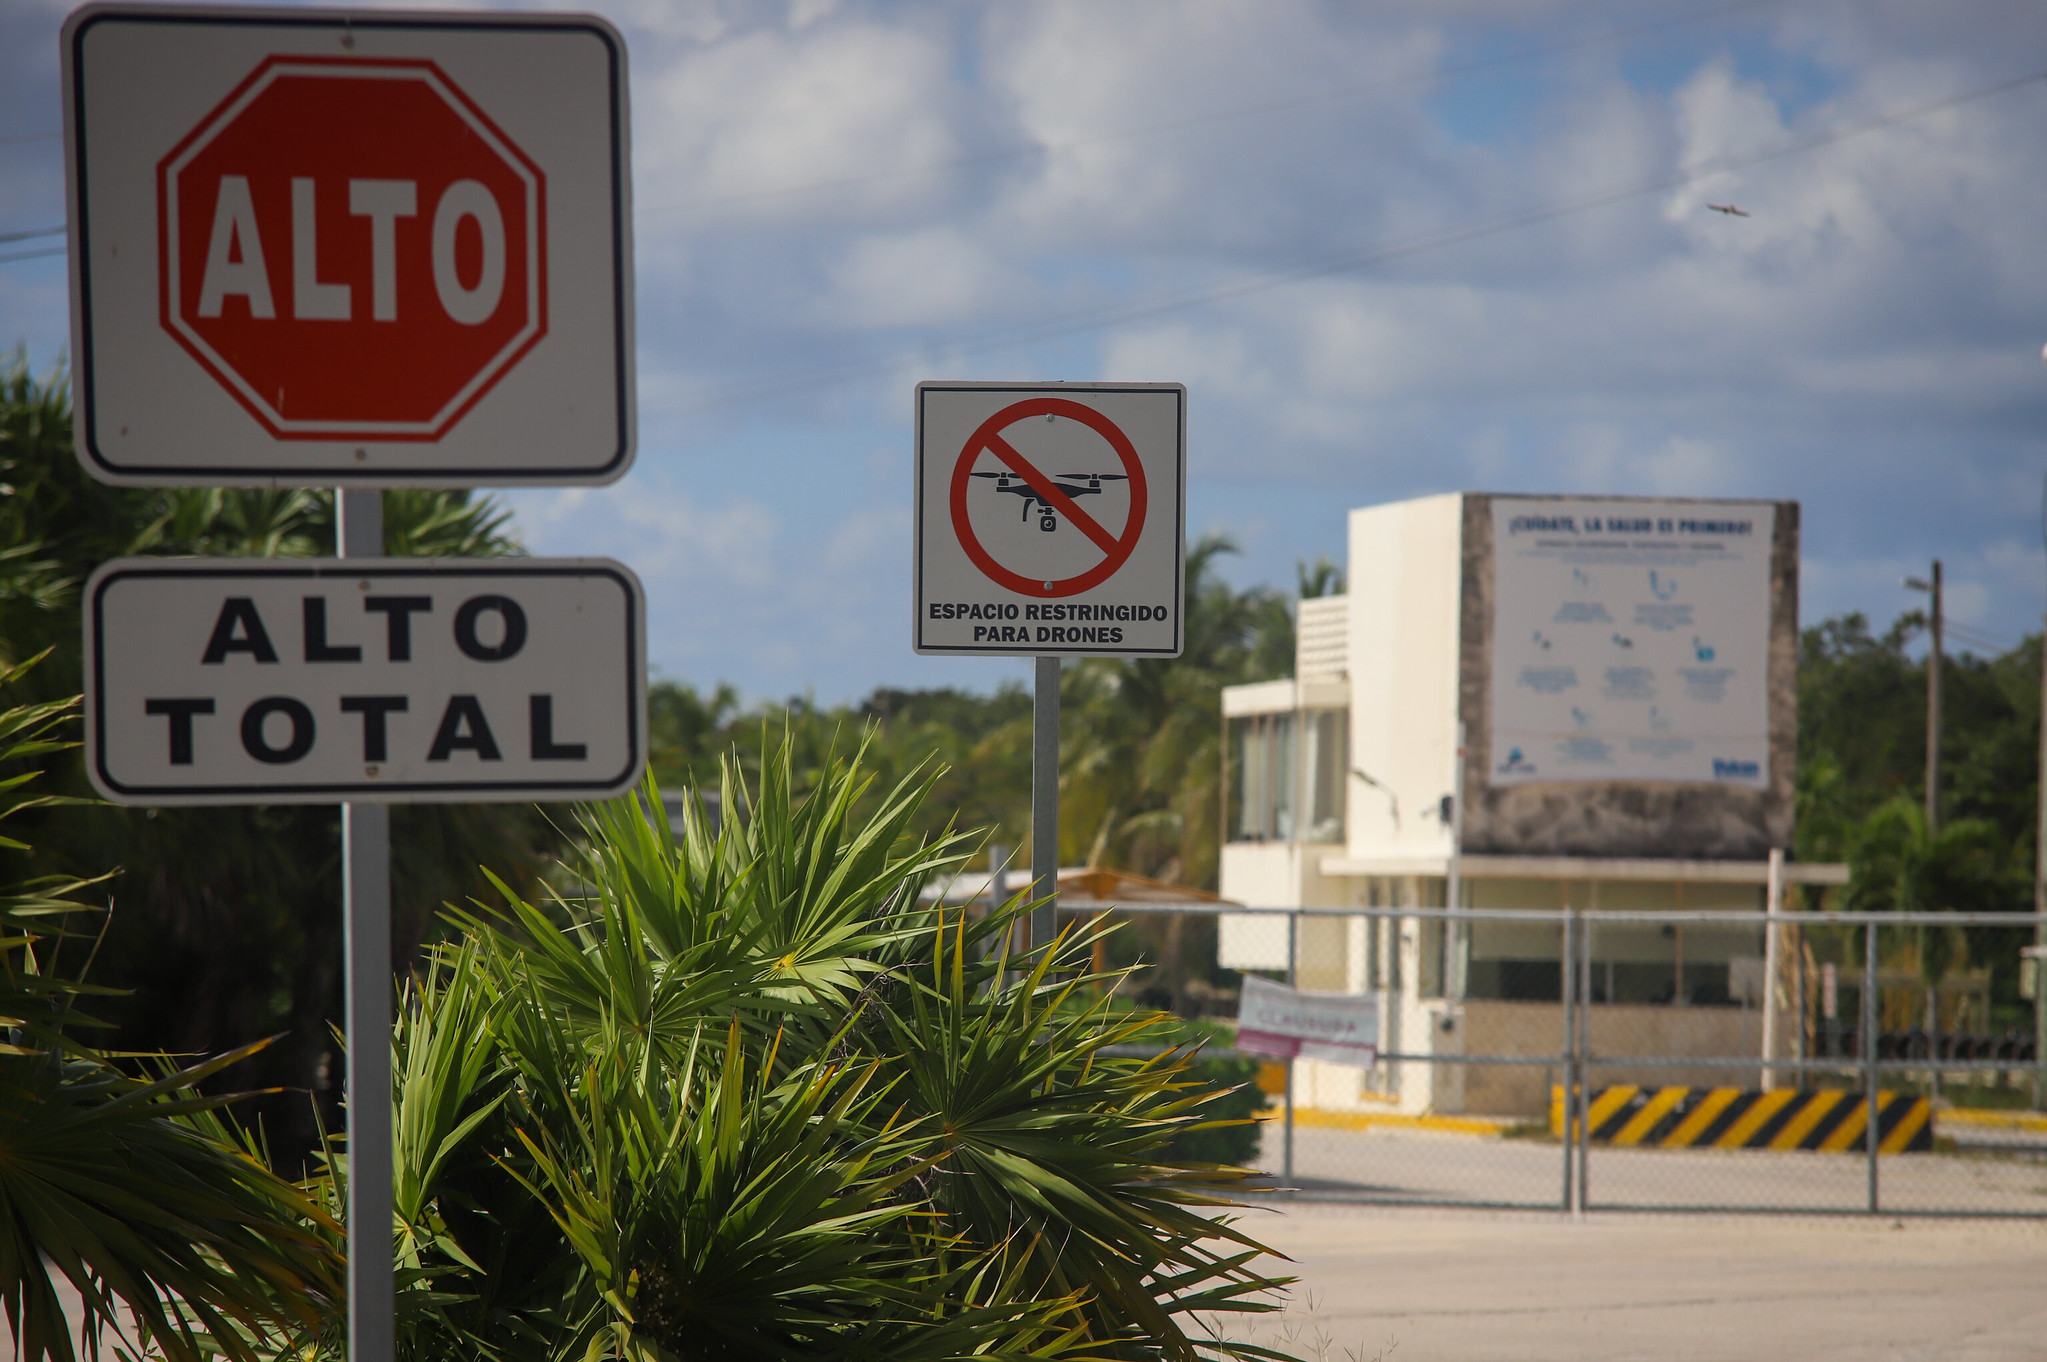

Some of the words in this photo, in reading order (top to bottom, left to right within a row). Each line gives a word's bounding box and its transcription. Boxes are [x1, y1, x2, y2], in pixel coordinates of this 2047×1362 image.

[198, 174, 506, 326] ALTO
[1585, 518, 1602, 533] LA
[1607, 518, 1653, 533] SALUD
[201, 594, 529, 665] ALTO
[929, 602, 1020, 620] ESPACIO
[1025, 604, 1168, 622] RESTRINGIDO
[973, 626, 1030, 642] PARA
[1036, 626, 1123, 643] DRONES
[145, 693, 588, 767] TOTAL
